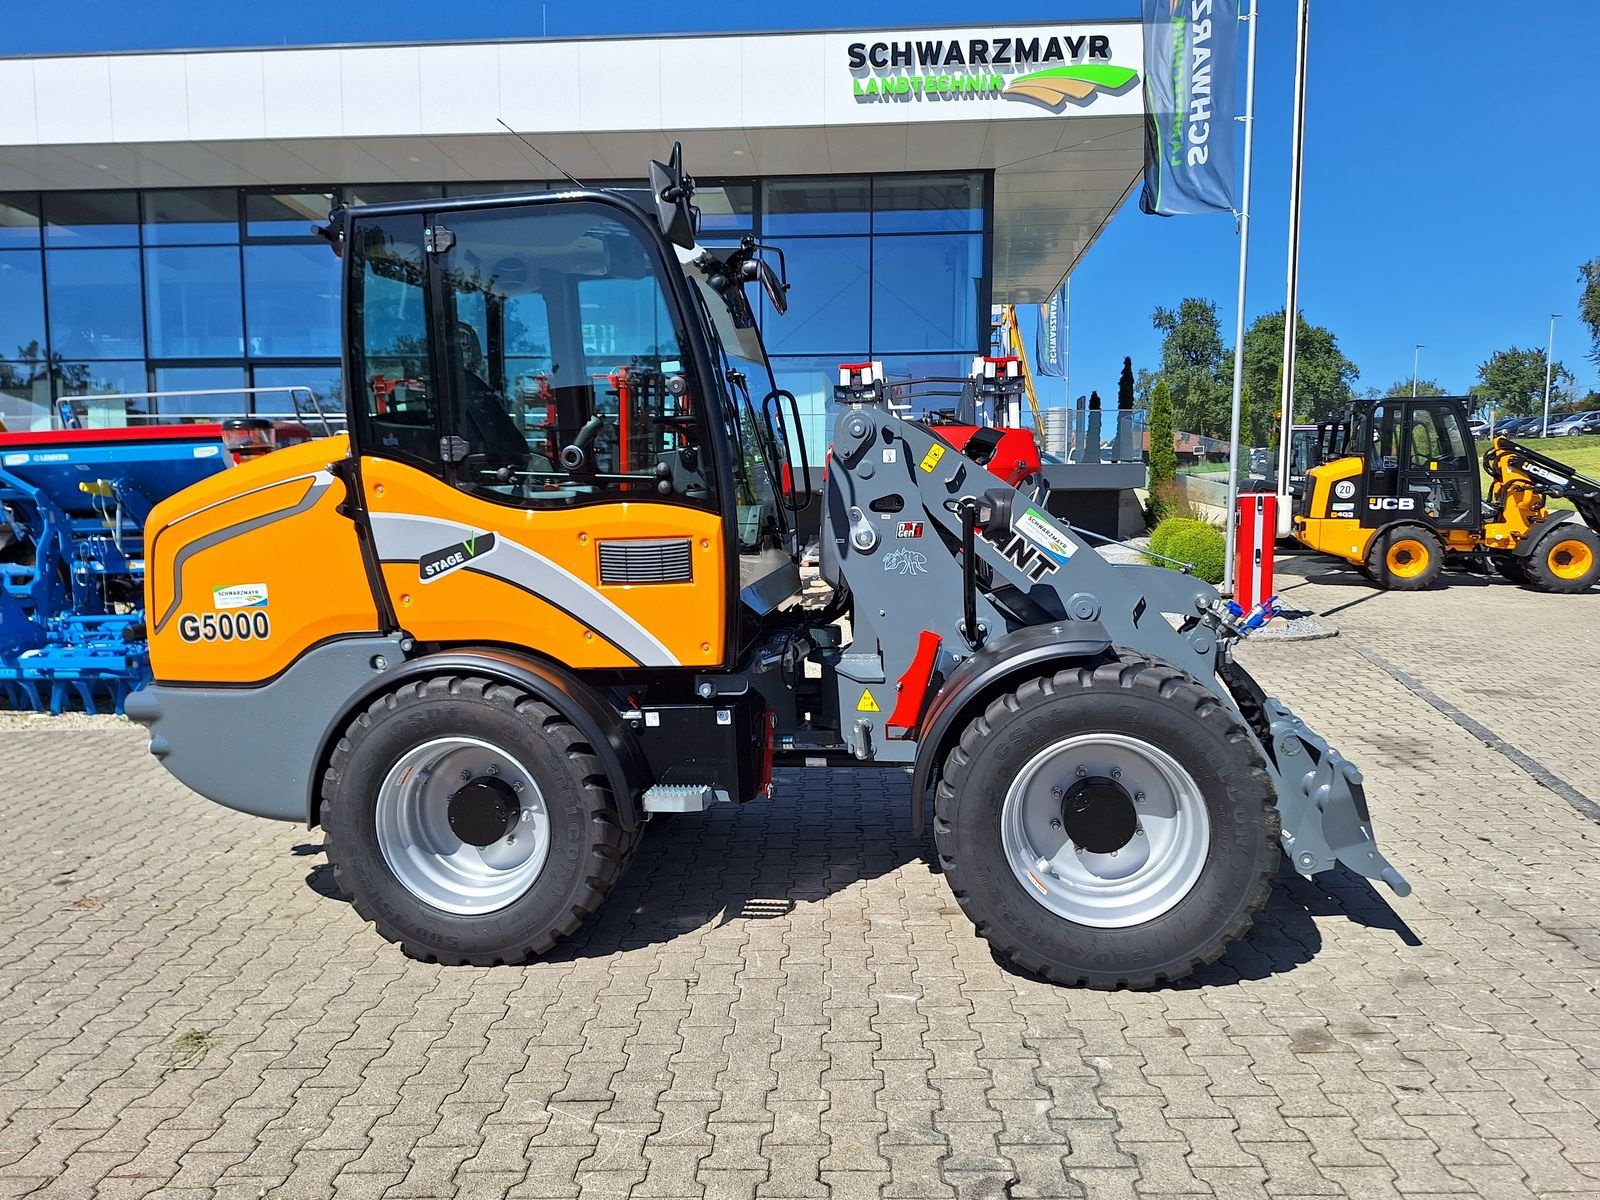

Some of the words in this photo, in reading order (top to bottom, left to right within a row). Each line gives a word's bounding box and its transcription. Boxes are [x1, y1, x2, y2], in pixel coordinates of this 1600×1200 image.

[848, 35, 1110, 68] SCHWARZMAYR
[853, 73, 1005, 96] LANDTECHNIK
[1521, 462, 1549, 480] JCB
[1339, 485, 1351, 494] 20
[1368, 497, 1415, 510] JCB
[1027, 516, 1068, 549] SCHWARZMAYR
[425, 552, 465, 576] STAGE
[179, 611, 270, 642] G5000
